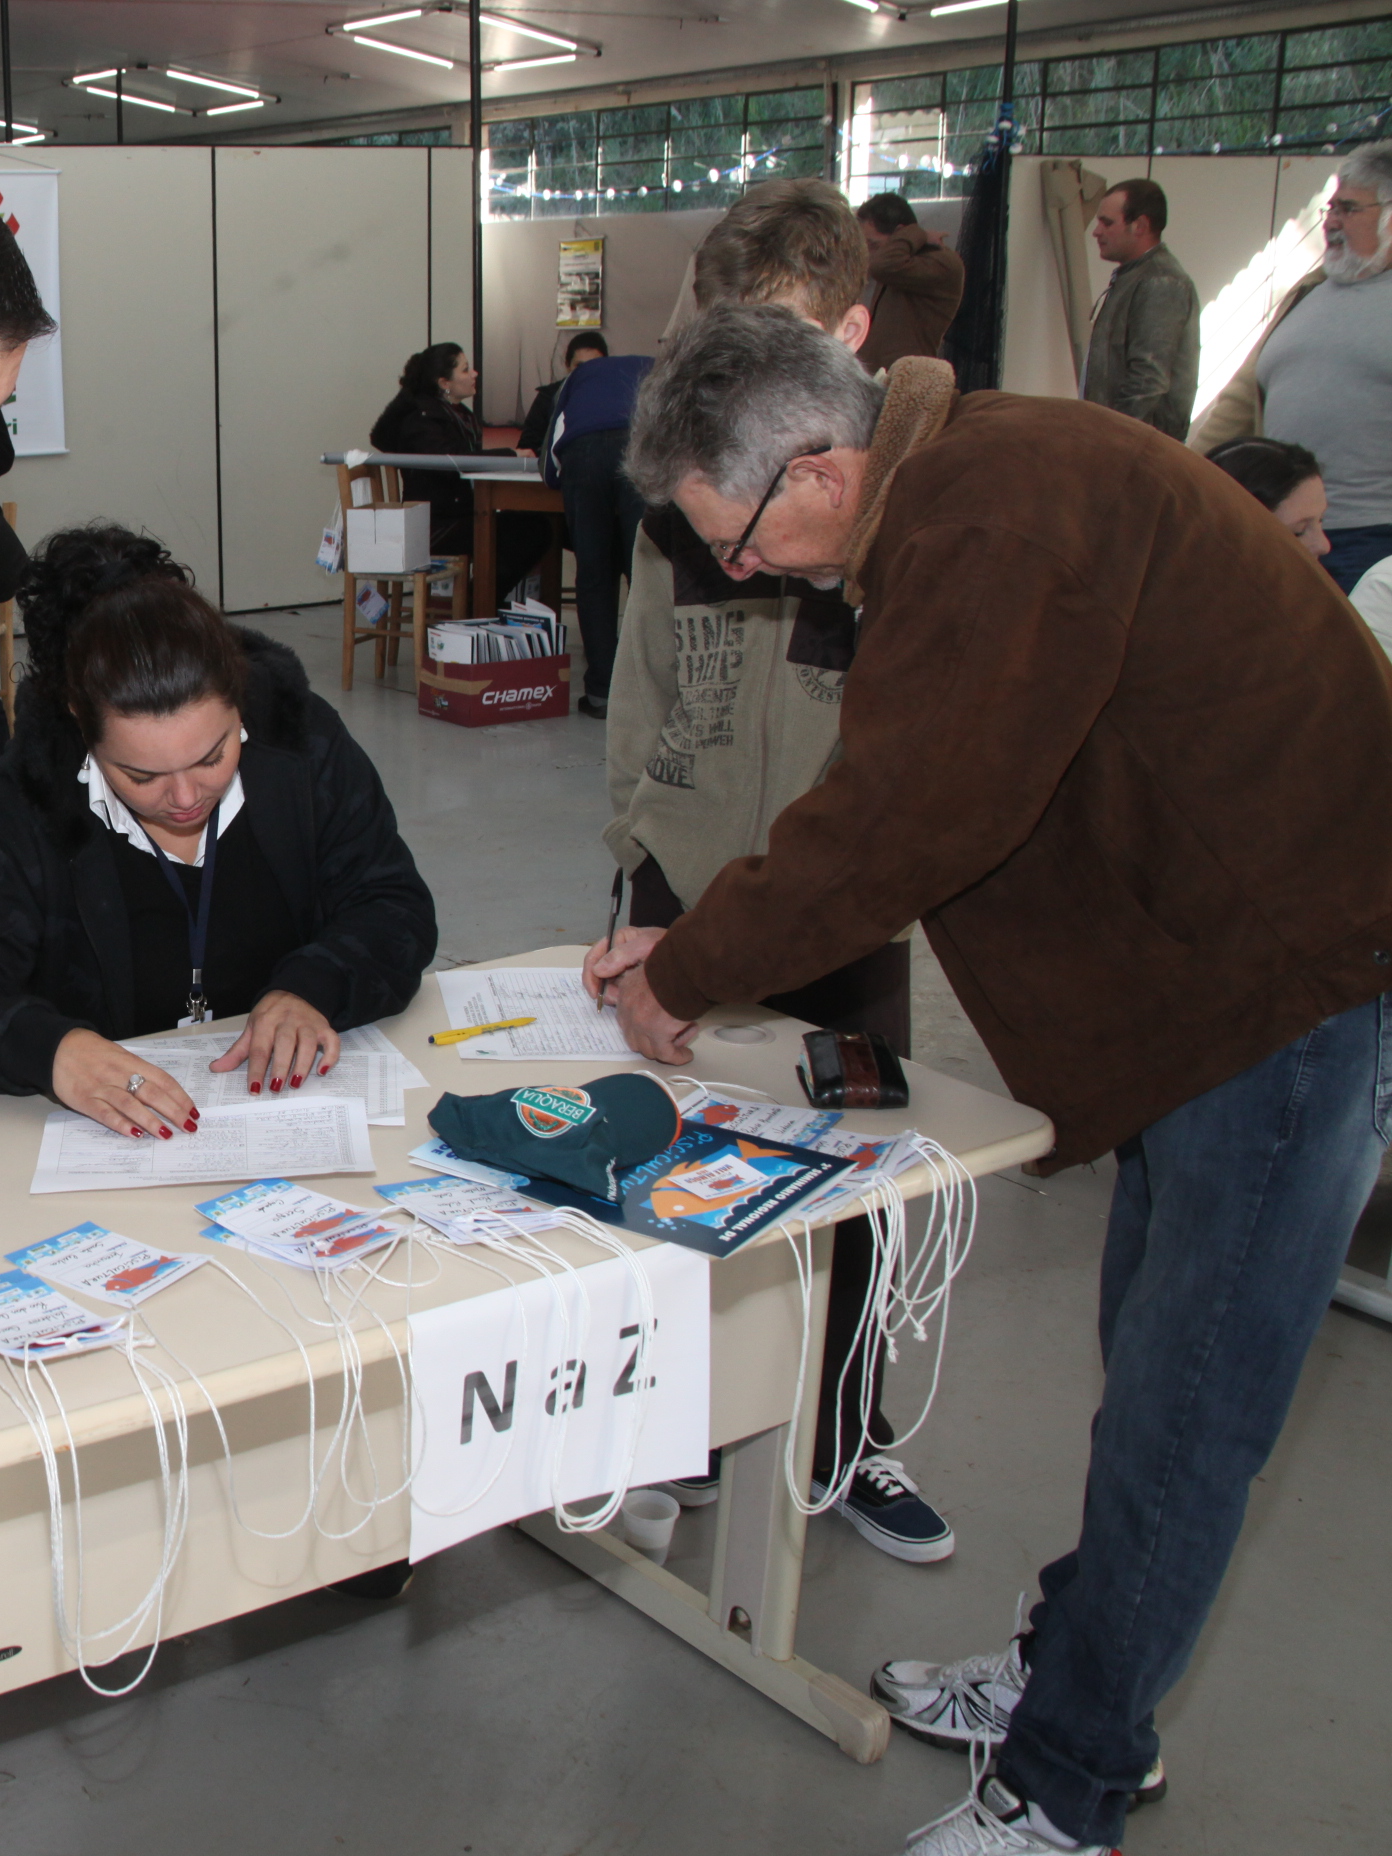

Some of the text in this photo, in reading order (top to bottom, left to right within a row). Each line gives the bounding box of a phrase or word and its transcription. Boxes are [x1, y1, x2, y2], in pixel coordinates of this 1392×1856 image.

[522, 1089, 585, 1120] BERAQUA
[774, 1168, 823, 1201] SEMINÁRIO
[731, 1198, 780, 1231] REGIONAL
[718, 1230, 738, 1242] DE
